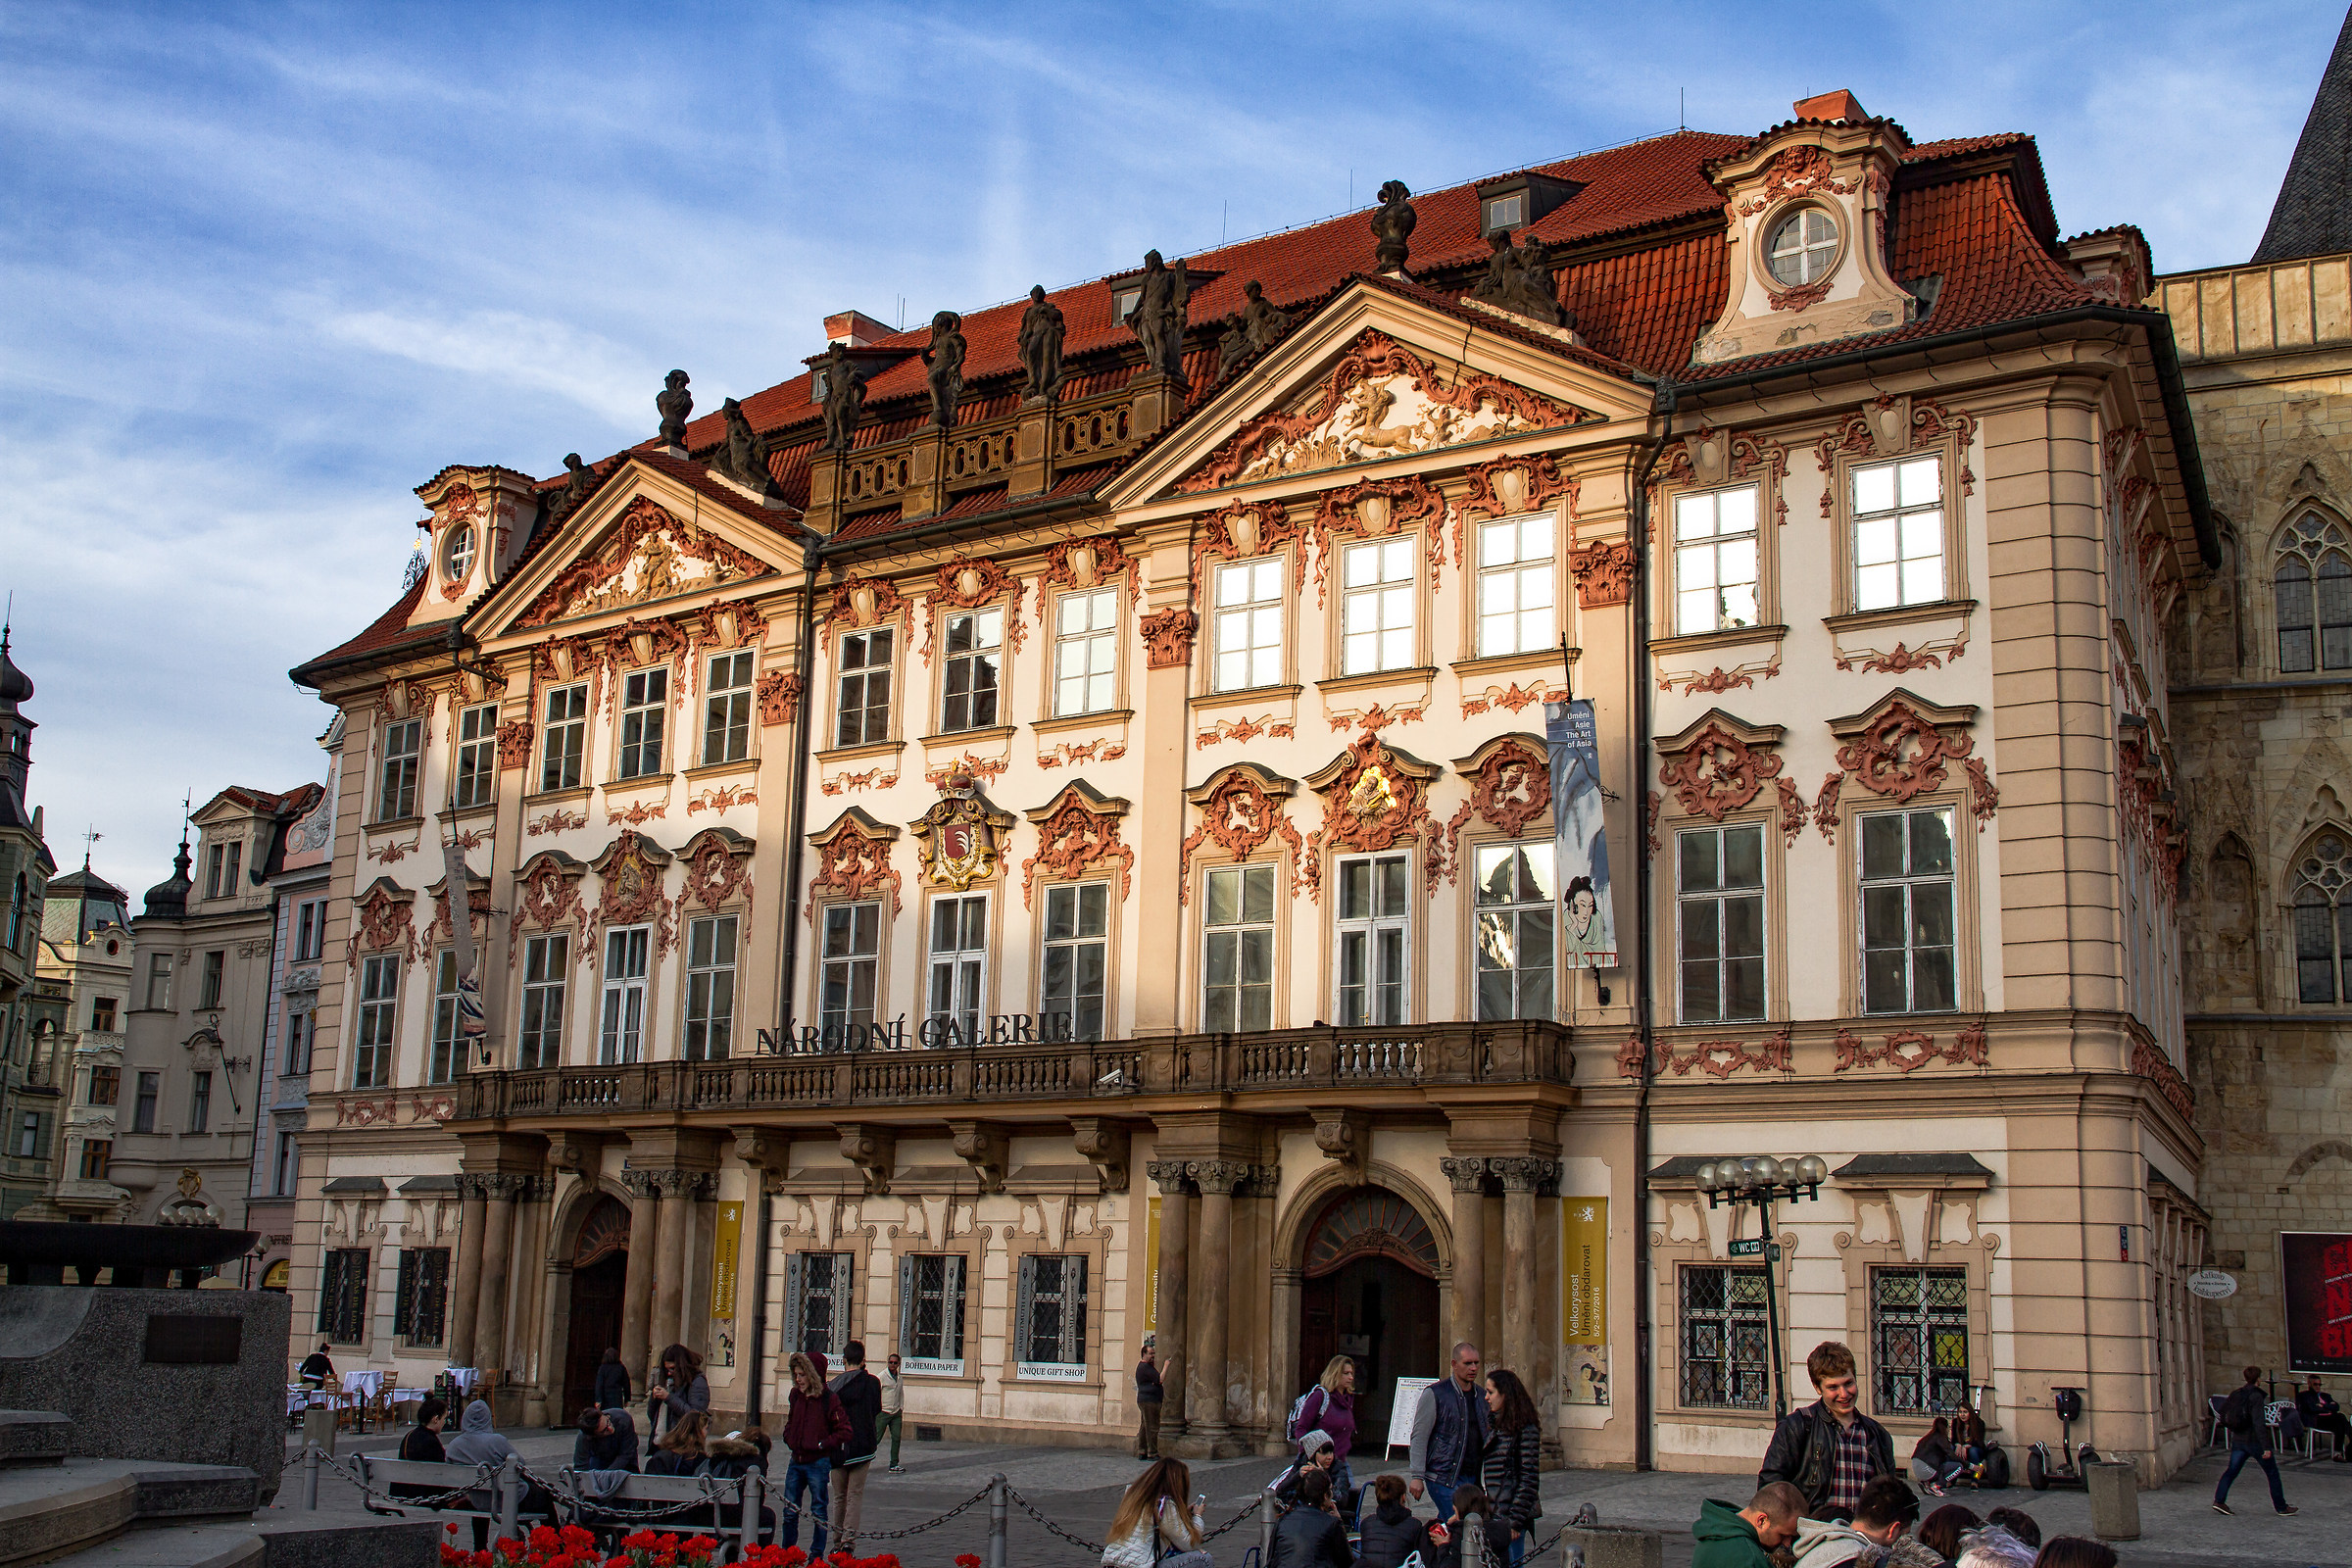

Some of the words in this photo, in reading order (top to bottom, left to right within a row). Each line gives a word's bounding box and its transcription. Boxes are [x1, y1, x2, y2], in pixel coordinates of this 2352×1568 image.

[755, 1012, 905, 1055] NÁRODNÍ
[918, 1011, 1073, 1048] GALERIE
[1738, 1242, 1750, 1253] WC
[1581, 1244, 1591, 1299] obdarovat
[353, 1297, 359, 1308] DE
[788, 1280, 796, 1344] MANUFAKTURA
[1569, 1274, 1581, 1336] Velkorysost
[1581, 1301, 1591, 1336] Umění
[905, 1362, 936, 1370] BOHEMIA
[1019, 1367, 1046, 1376] UNIQUE
[1065, 1368, 1085, 1377] SHOP
